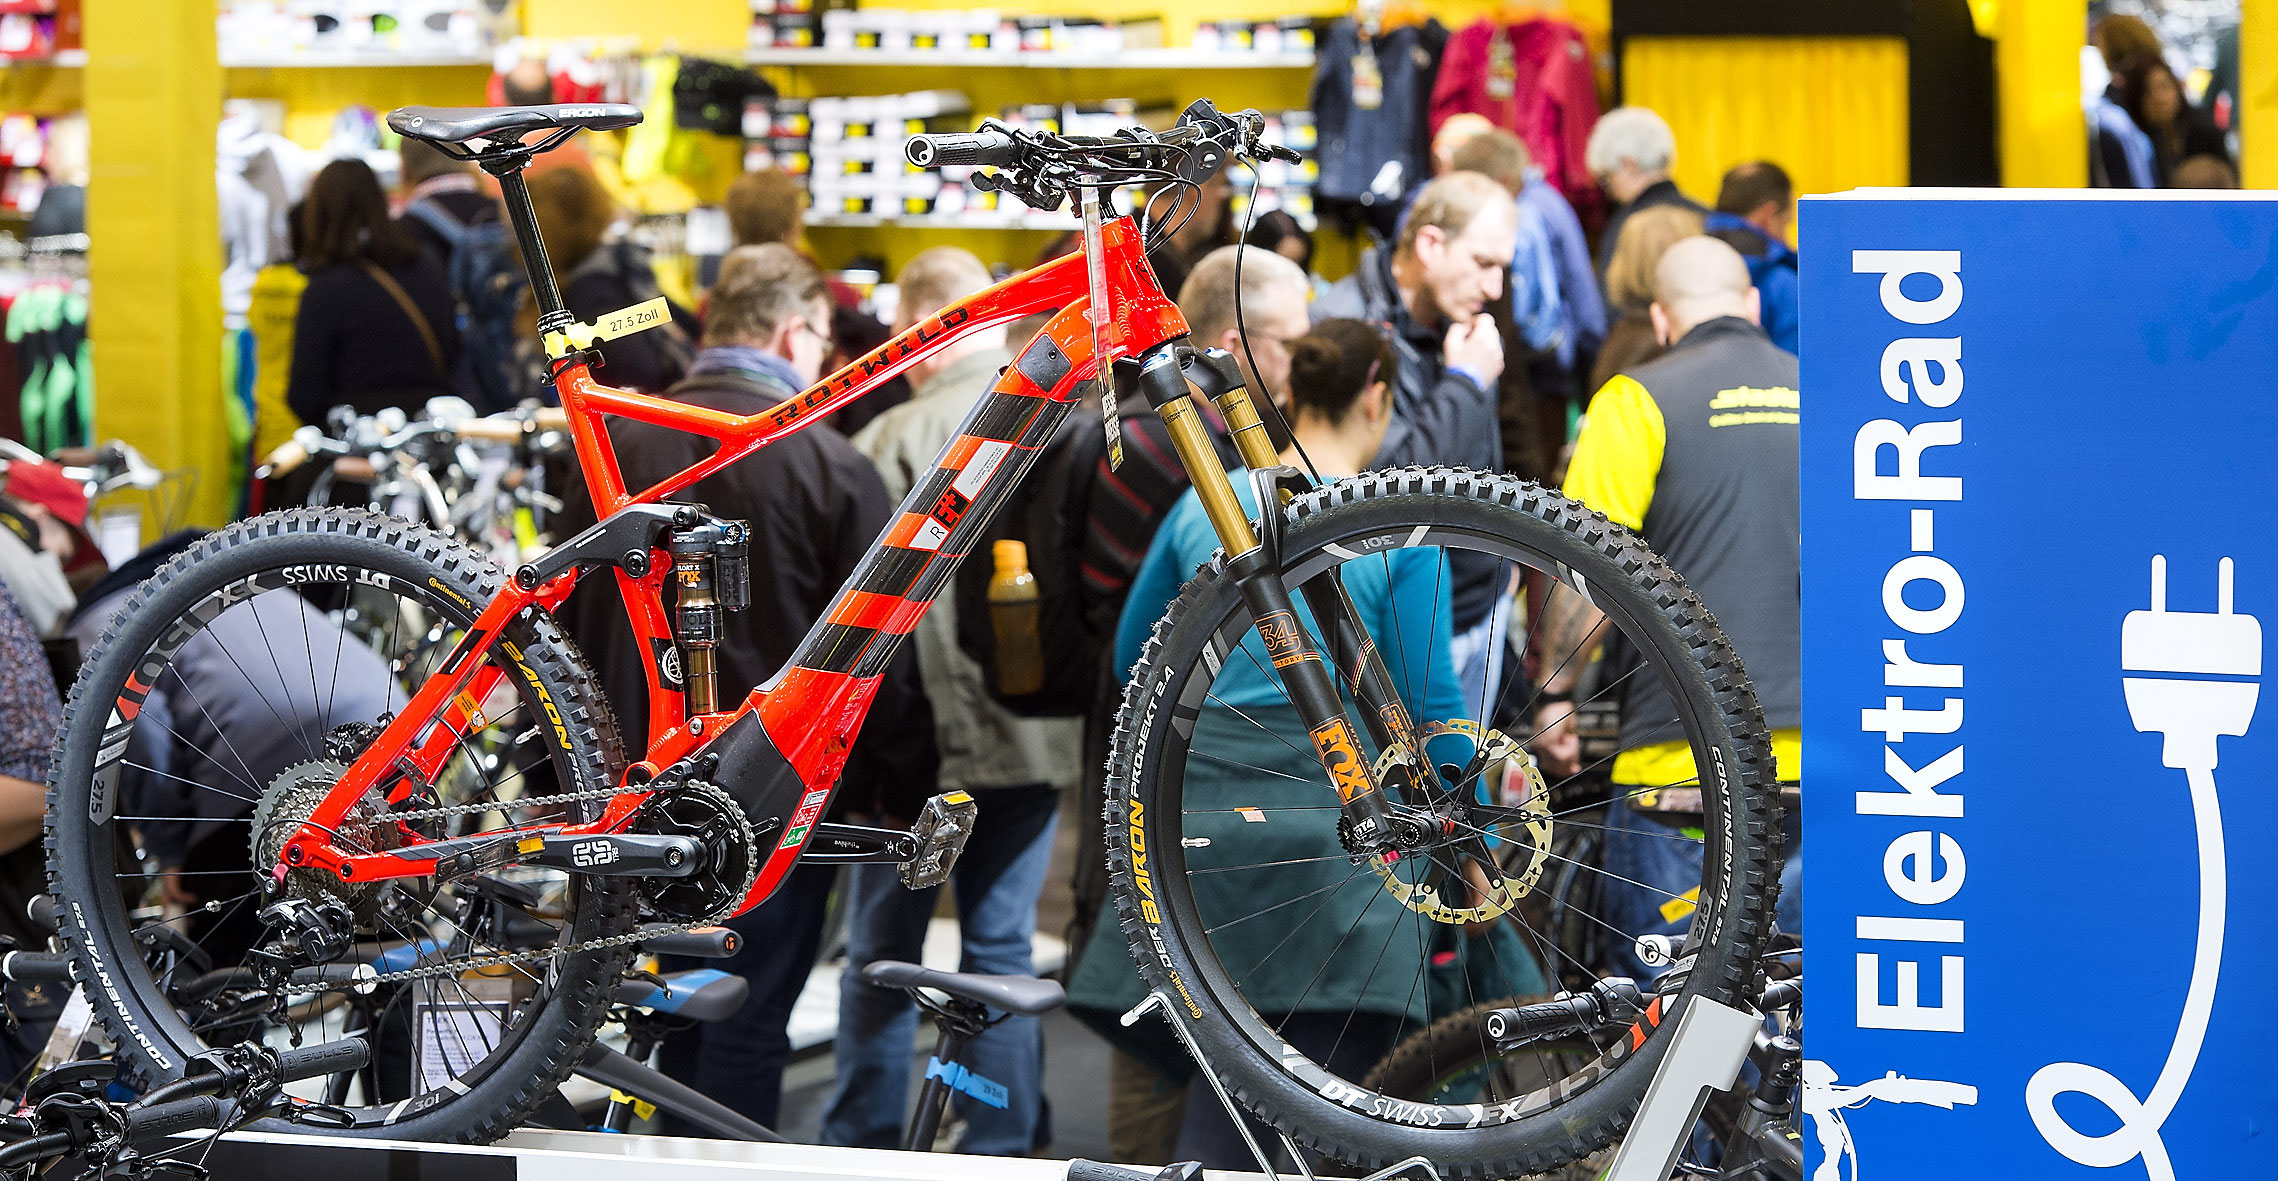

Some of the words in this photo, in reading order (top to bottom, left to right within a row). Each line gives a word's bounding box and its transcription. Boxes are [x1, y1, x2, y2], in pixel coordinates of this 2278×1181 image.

[558, 108, 606, 118] ERGON
[609, 317, 635, 333] 27.5
[637, 309, 659, 325] Zoll
[770, 307, 969, 428] ROTWILD
[282, 565, 348, 584] SWISS
[355, 569, 392, 590] DT
[677, 570, 701, 585] FOX
[1258, 618, 1294, 651] 34
[1852, 250, 1966, 1033] Elektro-Rad
[501, 640, 573, 751] BARON
[1154, 665, 1176, 698] 2.4
[1130, 696, 1159, 799] PROJEKT
[1315, 722, 1373, 800] FOX
[91, 780, 105, 814] 27.5
[1711, 745, 1734, 913] CONTINENTAL
[1129, 798, 1162, 925] BARON
[1693, 901, 1710, 940] 27.5
[1148, 926, 1175, 969] DER
[84, 930, 173, 1070] CONTINENTAL
[414, 1098, 435, 1112] 30
[1318, 1078, 1368, 1109] DT
[1365, 1097, 1448, 1127] SWISS
